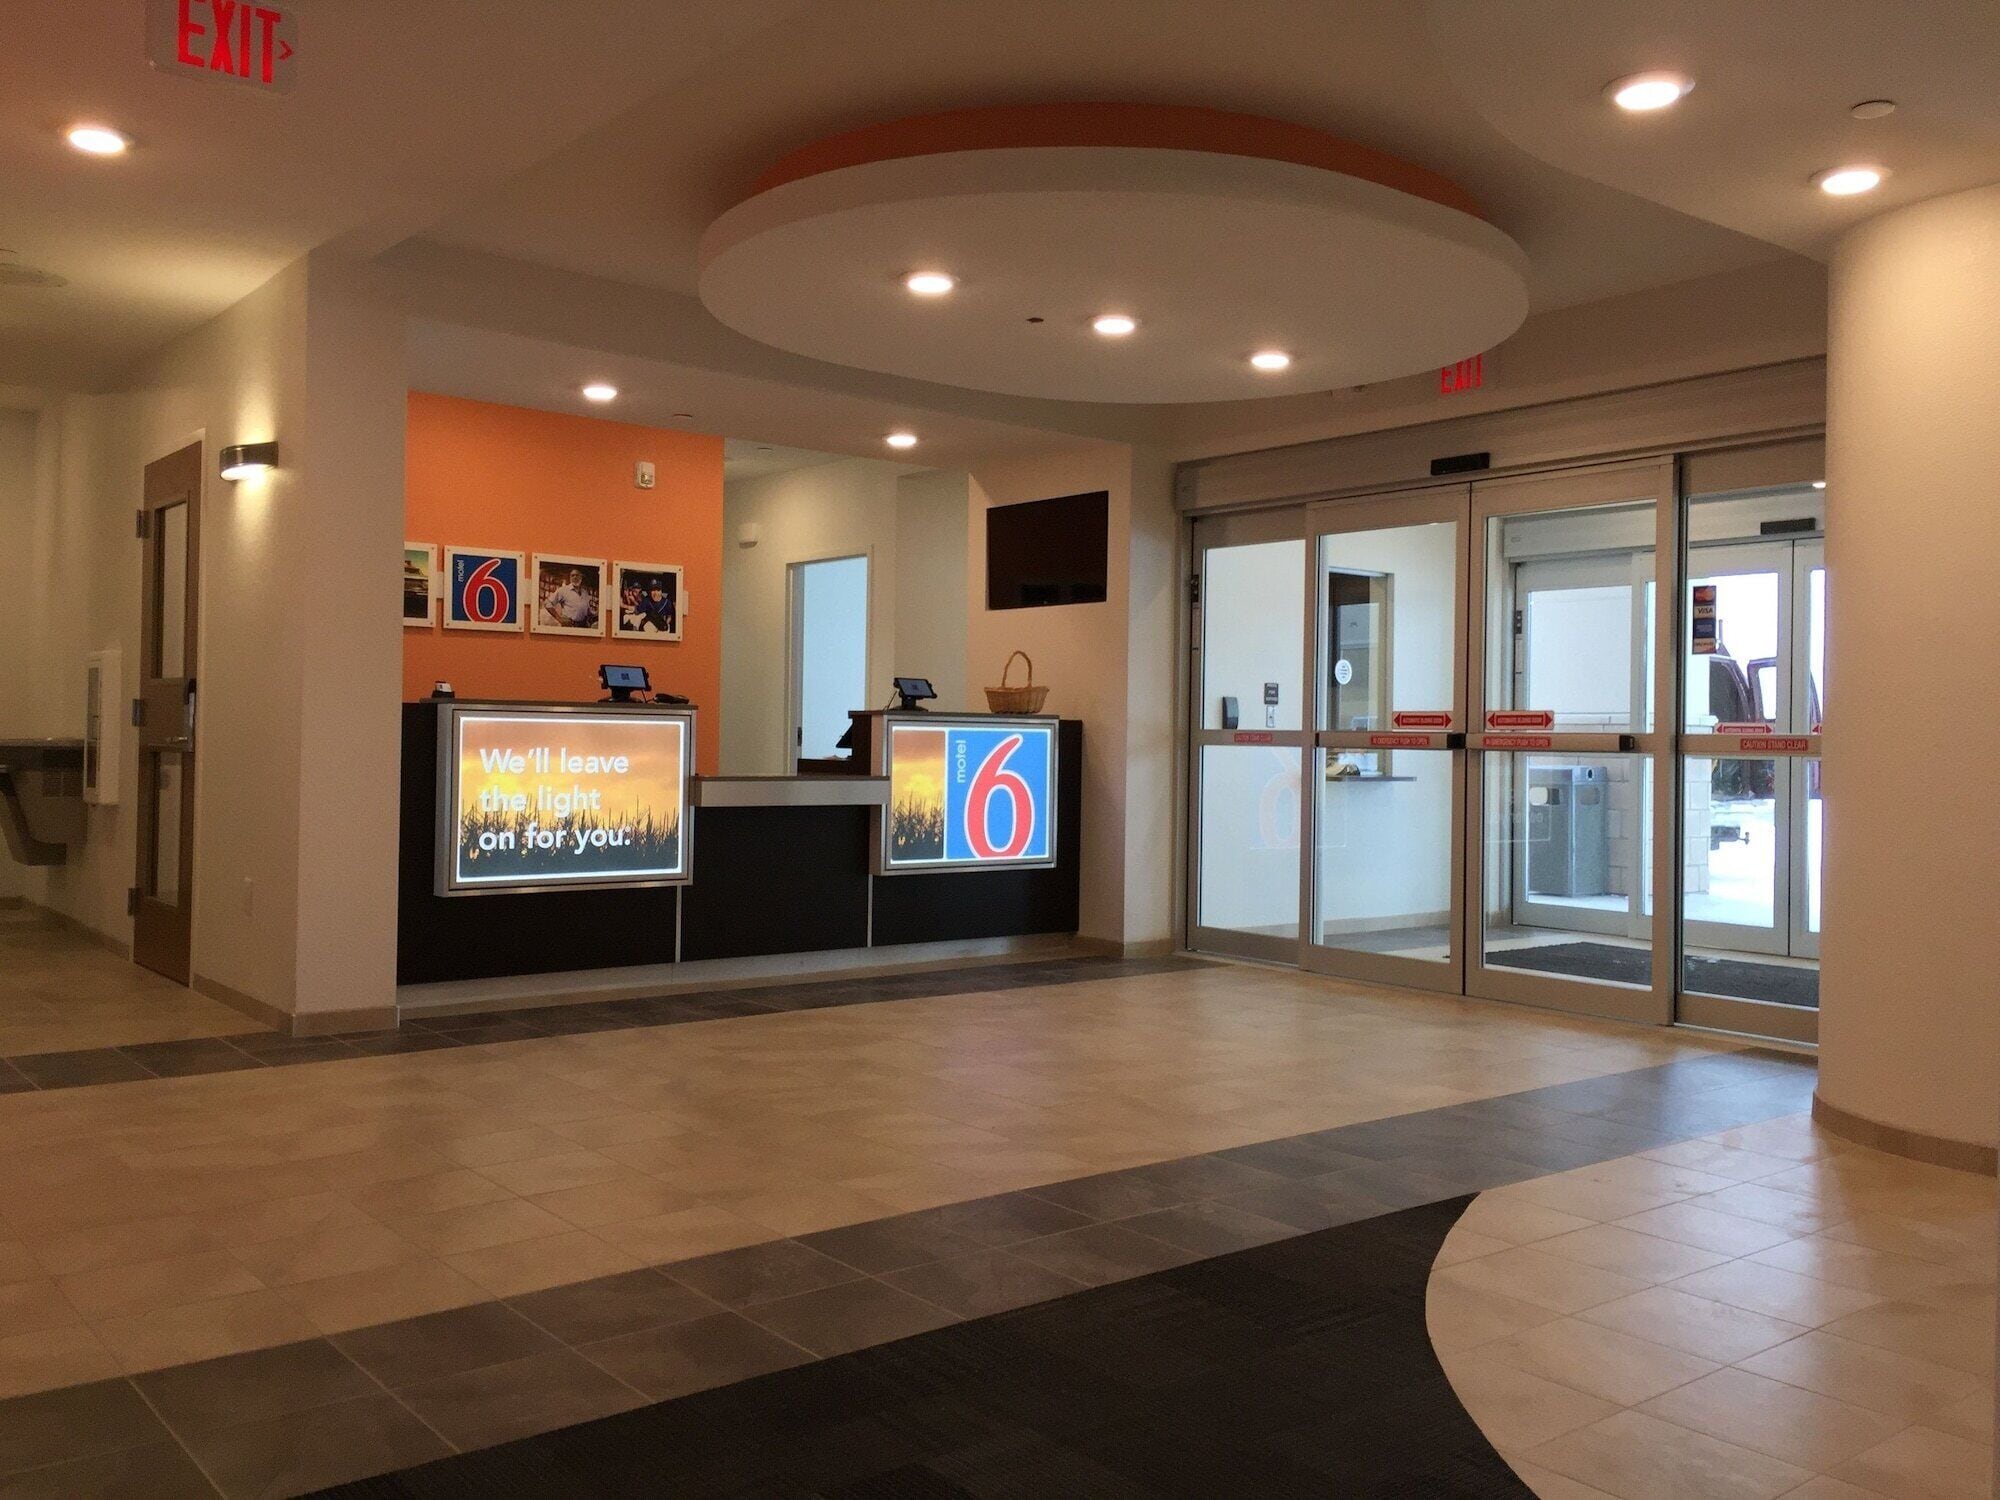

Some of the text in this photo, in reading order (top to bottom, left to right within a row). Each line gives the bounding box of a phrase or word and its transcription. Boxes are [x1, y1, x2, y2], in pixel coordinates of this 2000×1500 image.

[177, 0, 281, 84] EXIT
[457, 558, 510, 623] motel 6
[479, 747, 630, 774] We'll leave
[1743, 740, 1767, 749] CAUTION
[1786, 740, 1806, 750] CLEAR
[479, 785, 601, 818] the light
[955, 733, 1036, 859] motel 6
[478, 828, 515, 851] on
[526, 822, 568, 849] for
